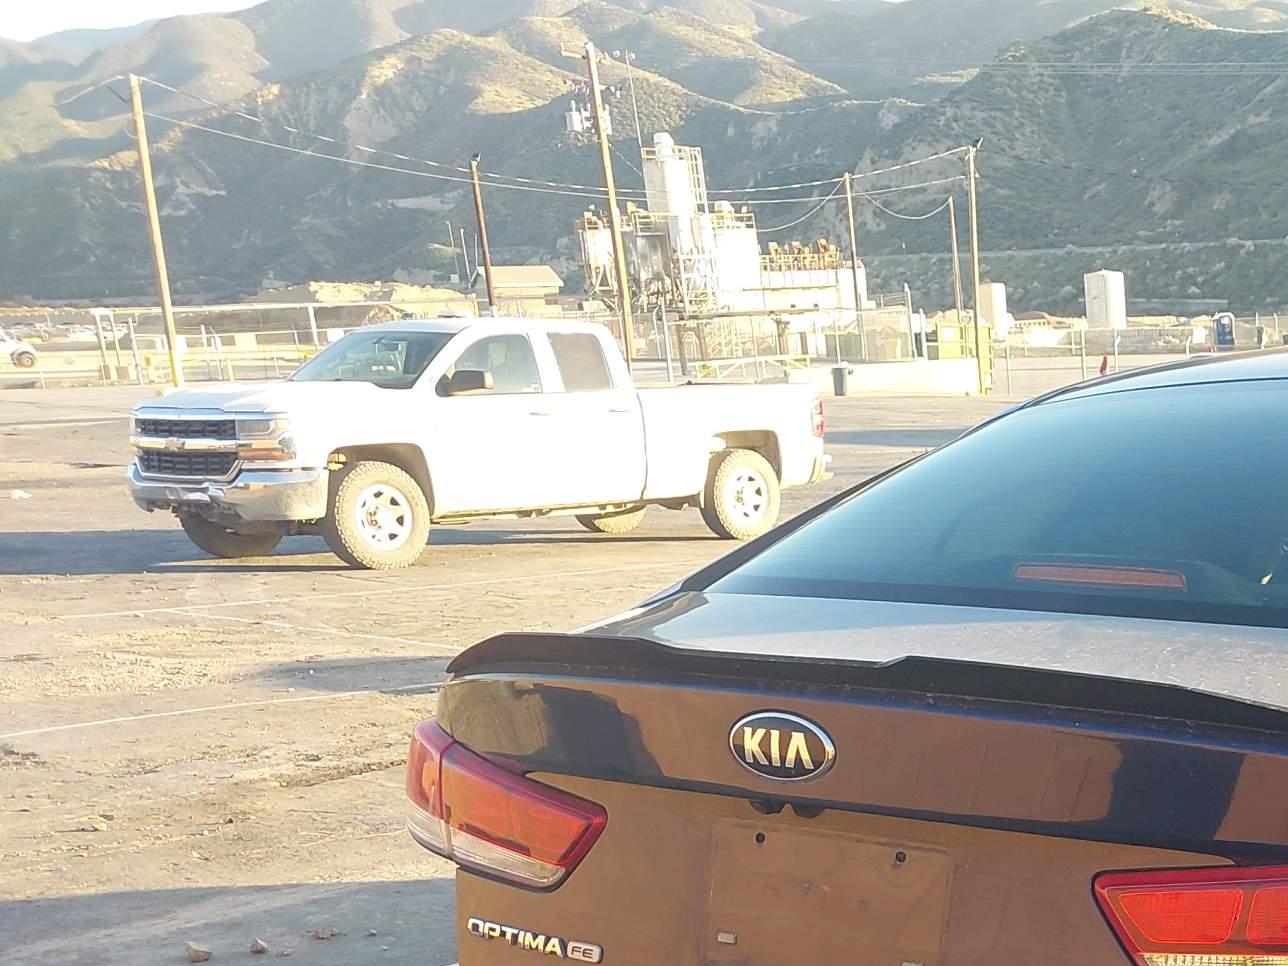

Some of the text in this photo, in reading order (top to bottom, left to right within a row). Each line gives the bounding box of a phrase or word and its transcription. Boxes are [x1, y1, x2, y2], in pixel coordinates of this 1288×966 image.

[743, 726, 815, 770] KIA
[467, 917, 594, 959] OPTIMA FE
